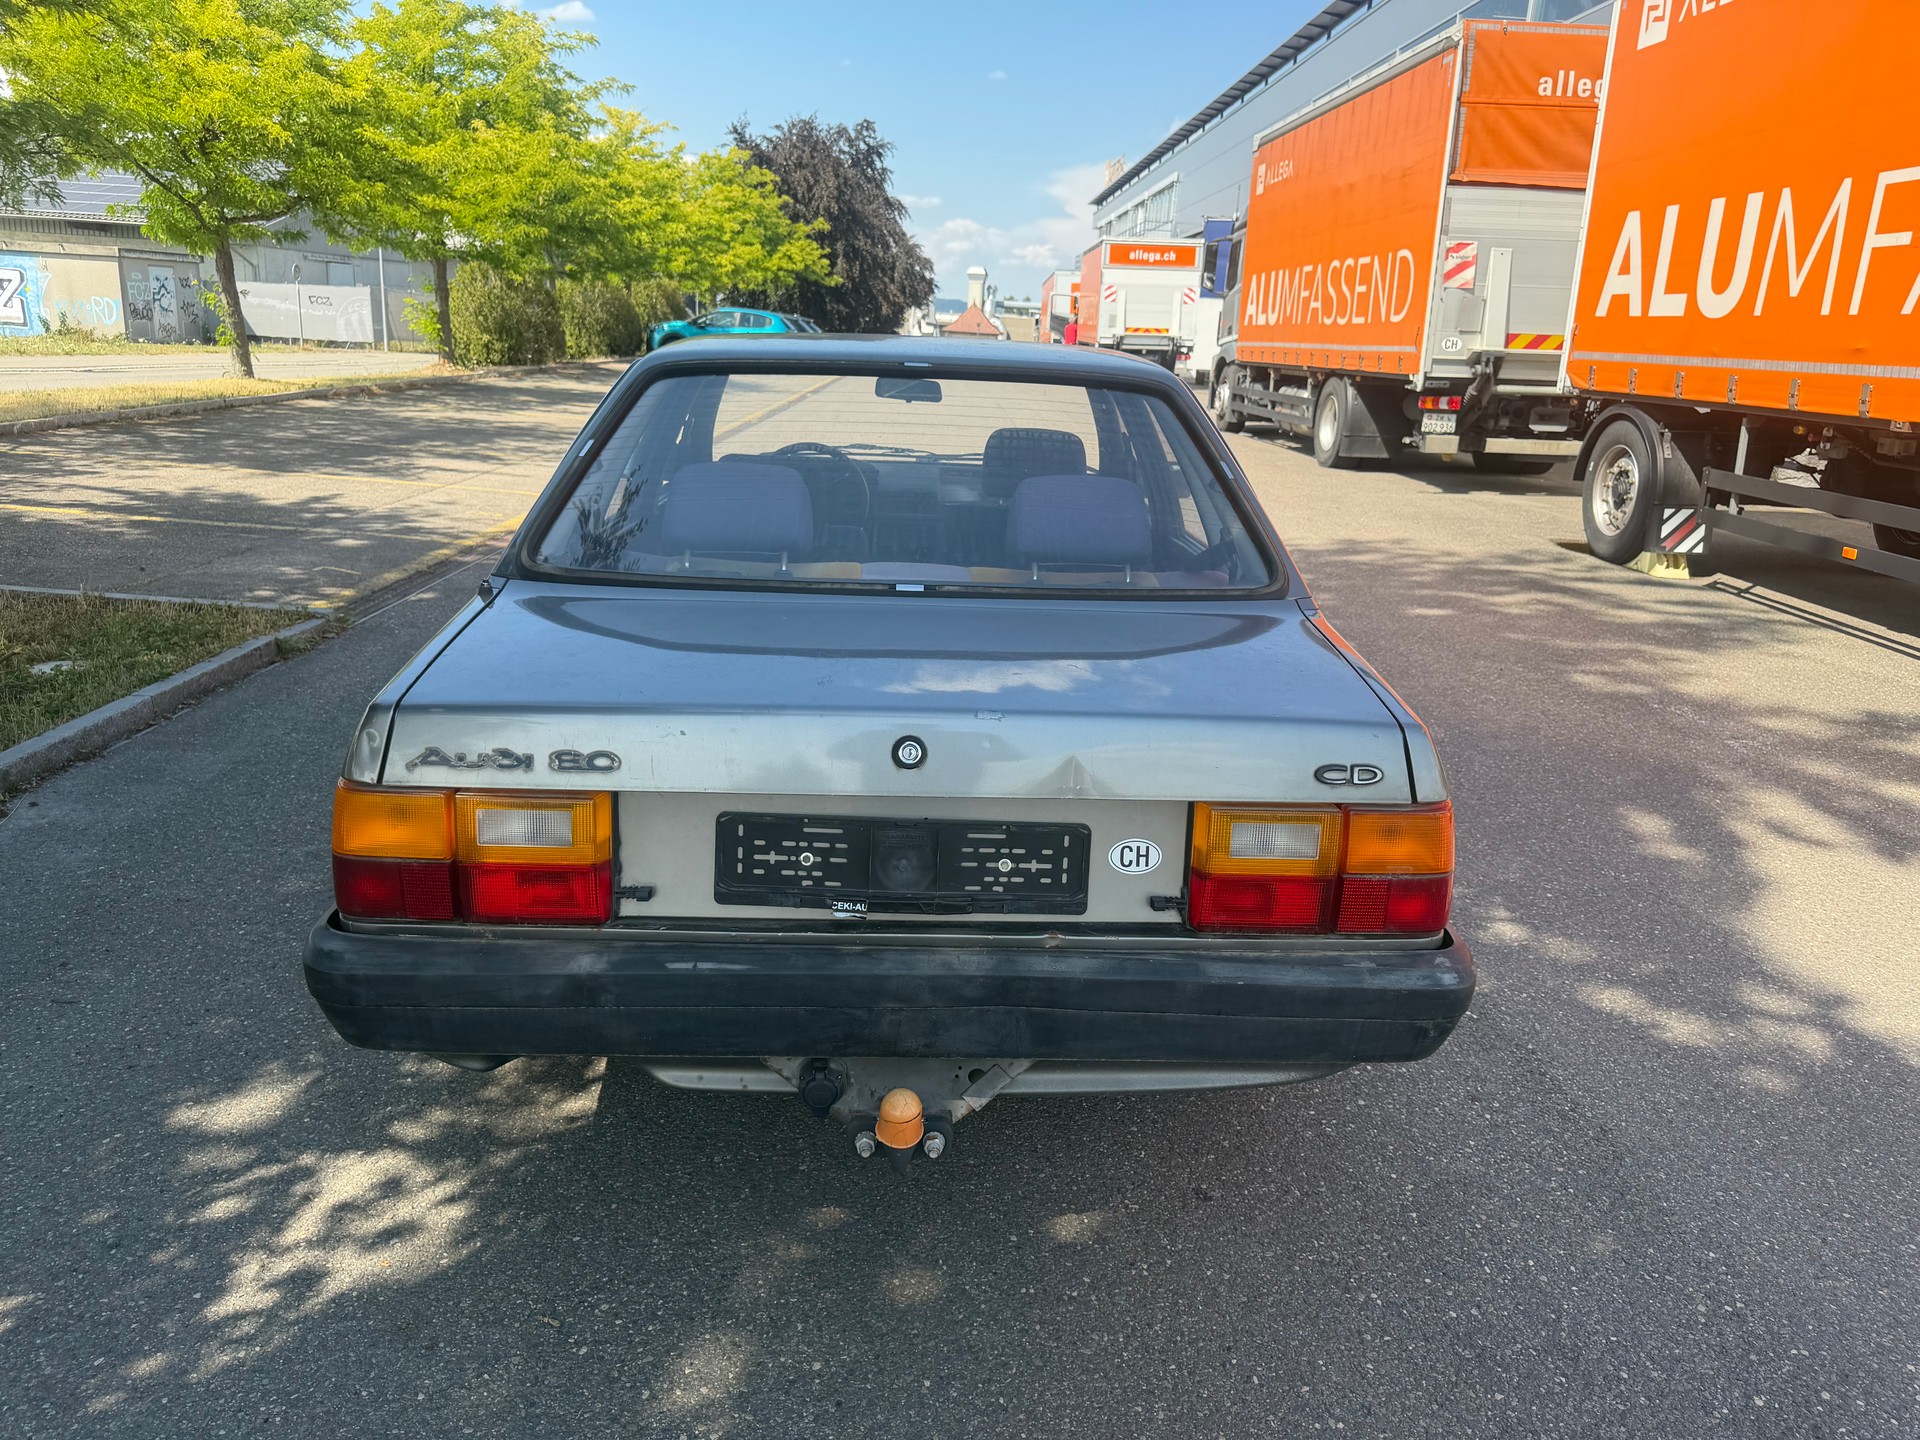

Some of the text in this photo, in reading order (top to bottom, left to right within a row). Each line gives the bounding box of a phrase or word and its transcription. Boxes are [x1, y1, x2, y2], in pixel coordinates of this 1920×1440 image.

[1265, 158, 1294, 187] ALLEGA
[1129, 249, 1176, 263] allega.ch
[1243, 248, 1415, 327] ALUMFASSEND
[308, 295, 333, 307] FCZ
[1444, 338, 1459, 350] CH
[548, 749, 622, 773] 80
[1313, 763, 1384, 786] CD
[1119, 845, 1151, 868] CH
